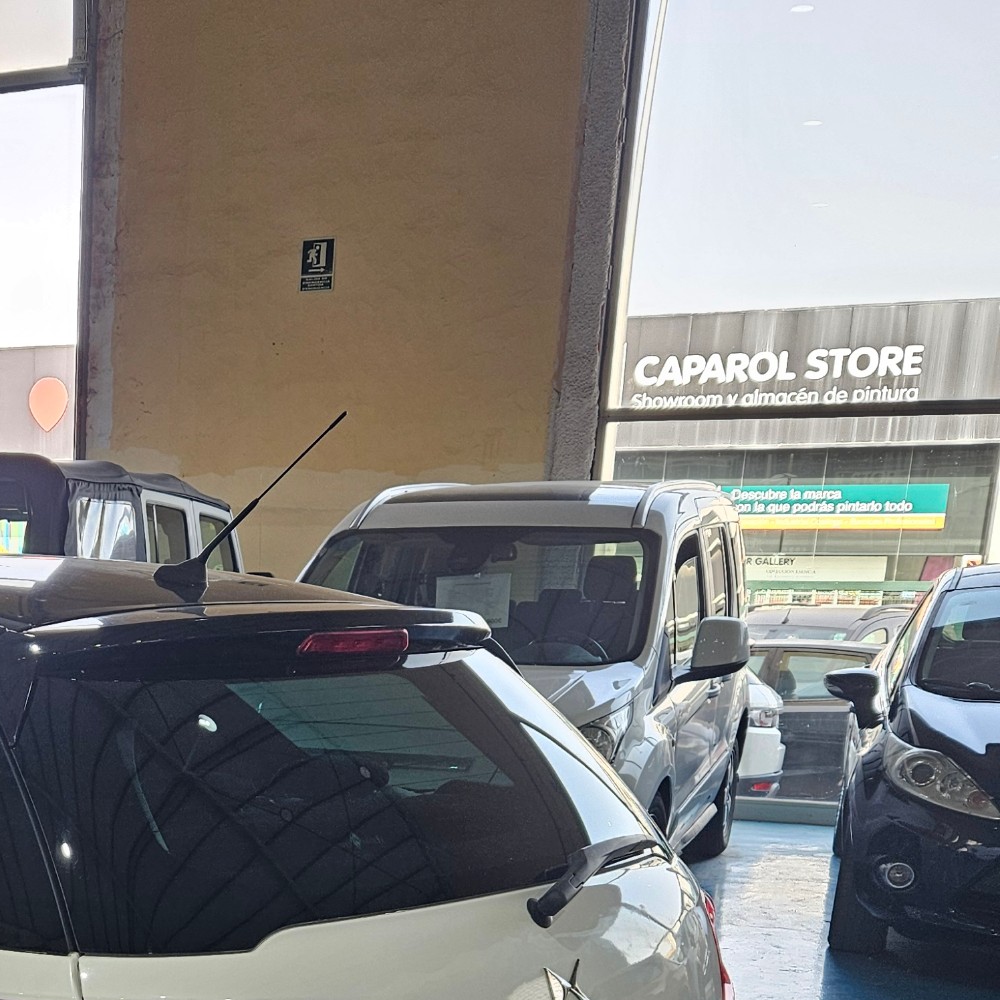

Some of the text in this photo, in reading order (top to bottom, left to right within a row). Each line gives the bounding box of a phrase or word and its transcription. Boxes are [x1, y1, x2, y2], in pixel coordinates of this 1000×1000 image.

[634, 344, 925, 387] CAPAROL STORE
[631, 392, 723, 409] Showroom
[740, 388, 819, 406] almacén
[823, 385, 848, 404] de
[850, 385, 919, 403] pintura
[732, 488, 842, 500] Descubre la marca
[735, 500, 913, 515] on la que podrás pintarlo todo
[755, 557, 796, 566] GALLERY
